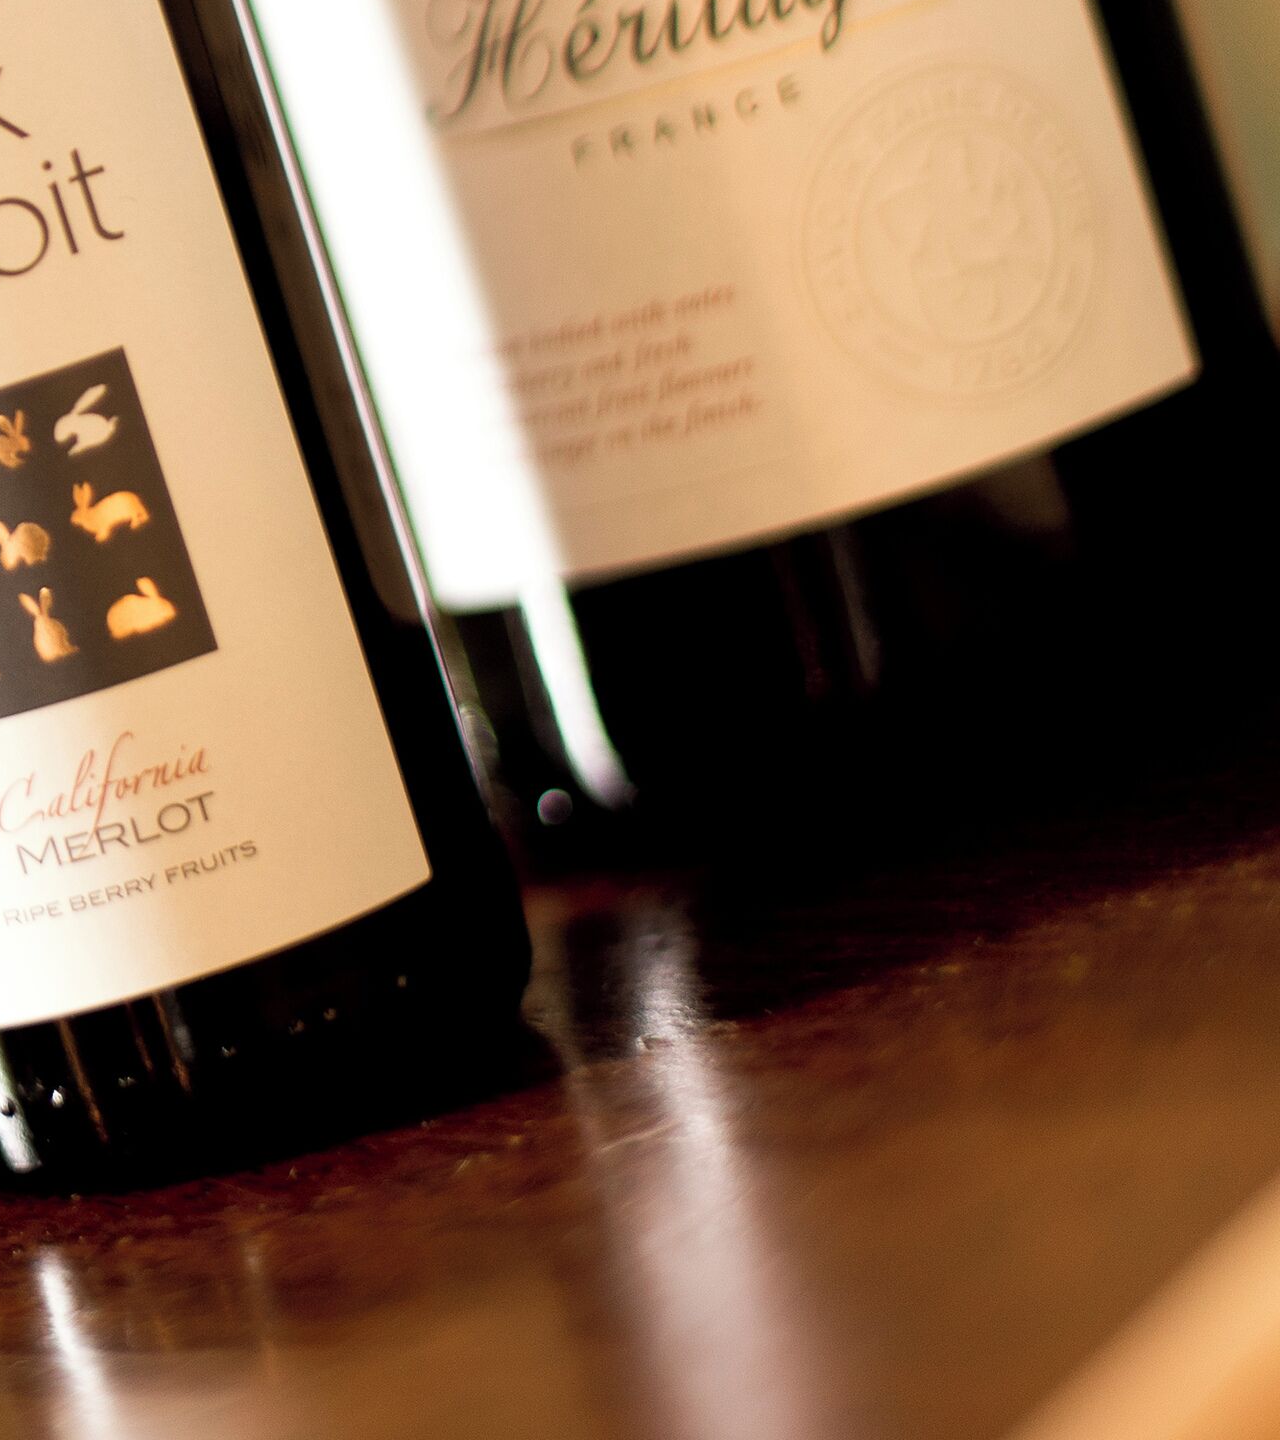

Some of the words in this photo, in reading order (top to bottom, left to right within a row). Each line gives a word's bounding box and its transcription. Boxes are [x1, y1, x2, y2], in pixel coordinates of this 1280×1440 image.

[571, 70, 804, 168] FRANCE
[15, 791, 215, 876] MERLOT
[2, 899, 63, 927] RIPE
[69, 873, 157, 913] BERRY
[164, 839, 259, 885] FRUITS
